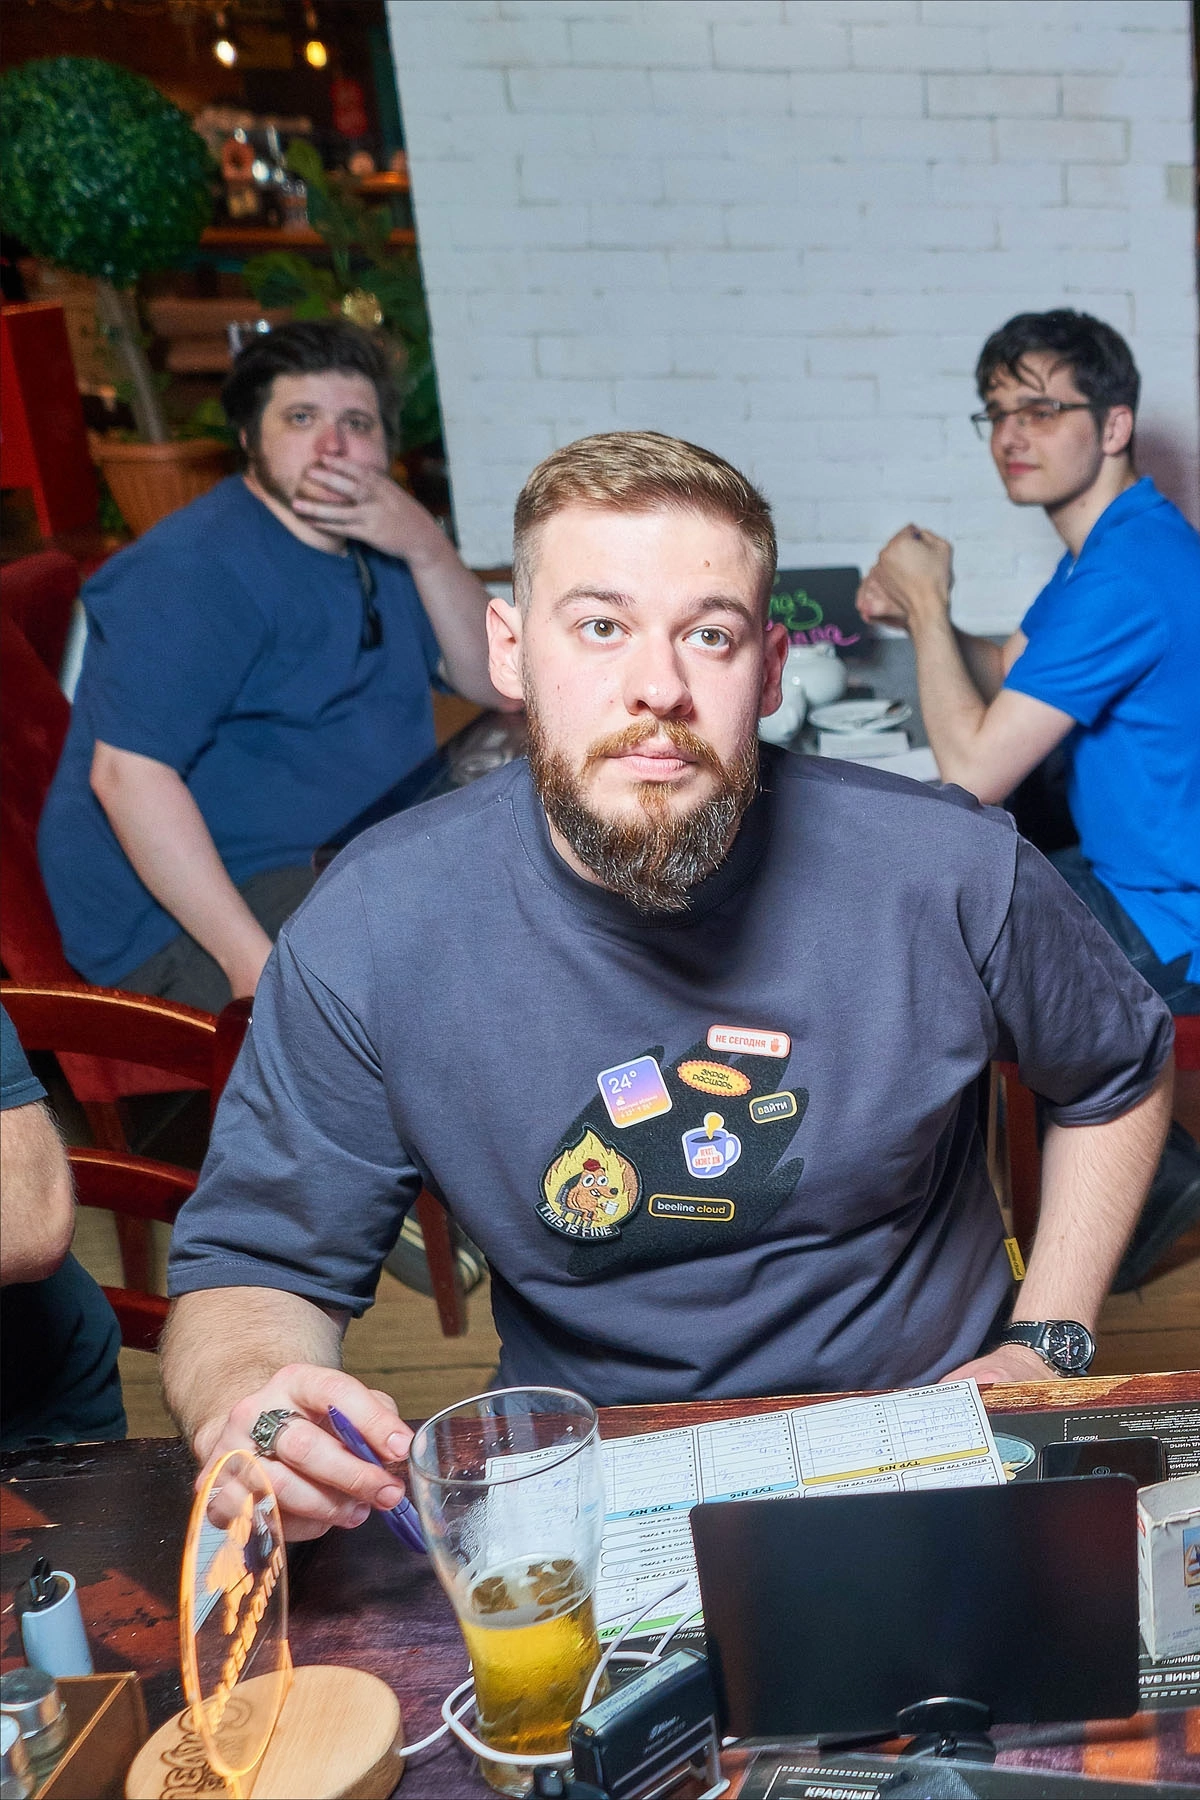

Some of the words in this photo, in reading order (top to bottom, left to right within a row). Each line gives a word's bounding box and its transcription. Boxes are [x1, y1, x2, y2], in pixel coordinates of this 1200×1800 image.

[715, 1034, 727, 1043] НЕ
[728, 1036, 767, 1048] СЕГОДНЯ
[608, 1070, 637, 1095] 24°
[657, 1201, 695, 1212] beeline
[696, 1204, 726, 1214] cloud
[540, 1202, 566, 1228] THIS
[565, 1223, 580, 1234] IS
[581, 1225, 613, 1237] FINE
[900, 1460, 920, 1468] ТУР
[1169, 1462, 1198, 1470] МИДИЙ
[729, 1490, 749, 1498] №6
[752, 1486, 773, 1494] ТУР
[628, 1508, 648, 1517] №7
[651, 1505, 673, 1513] ТУР
